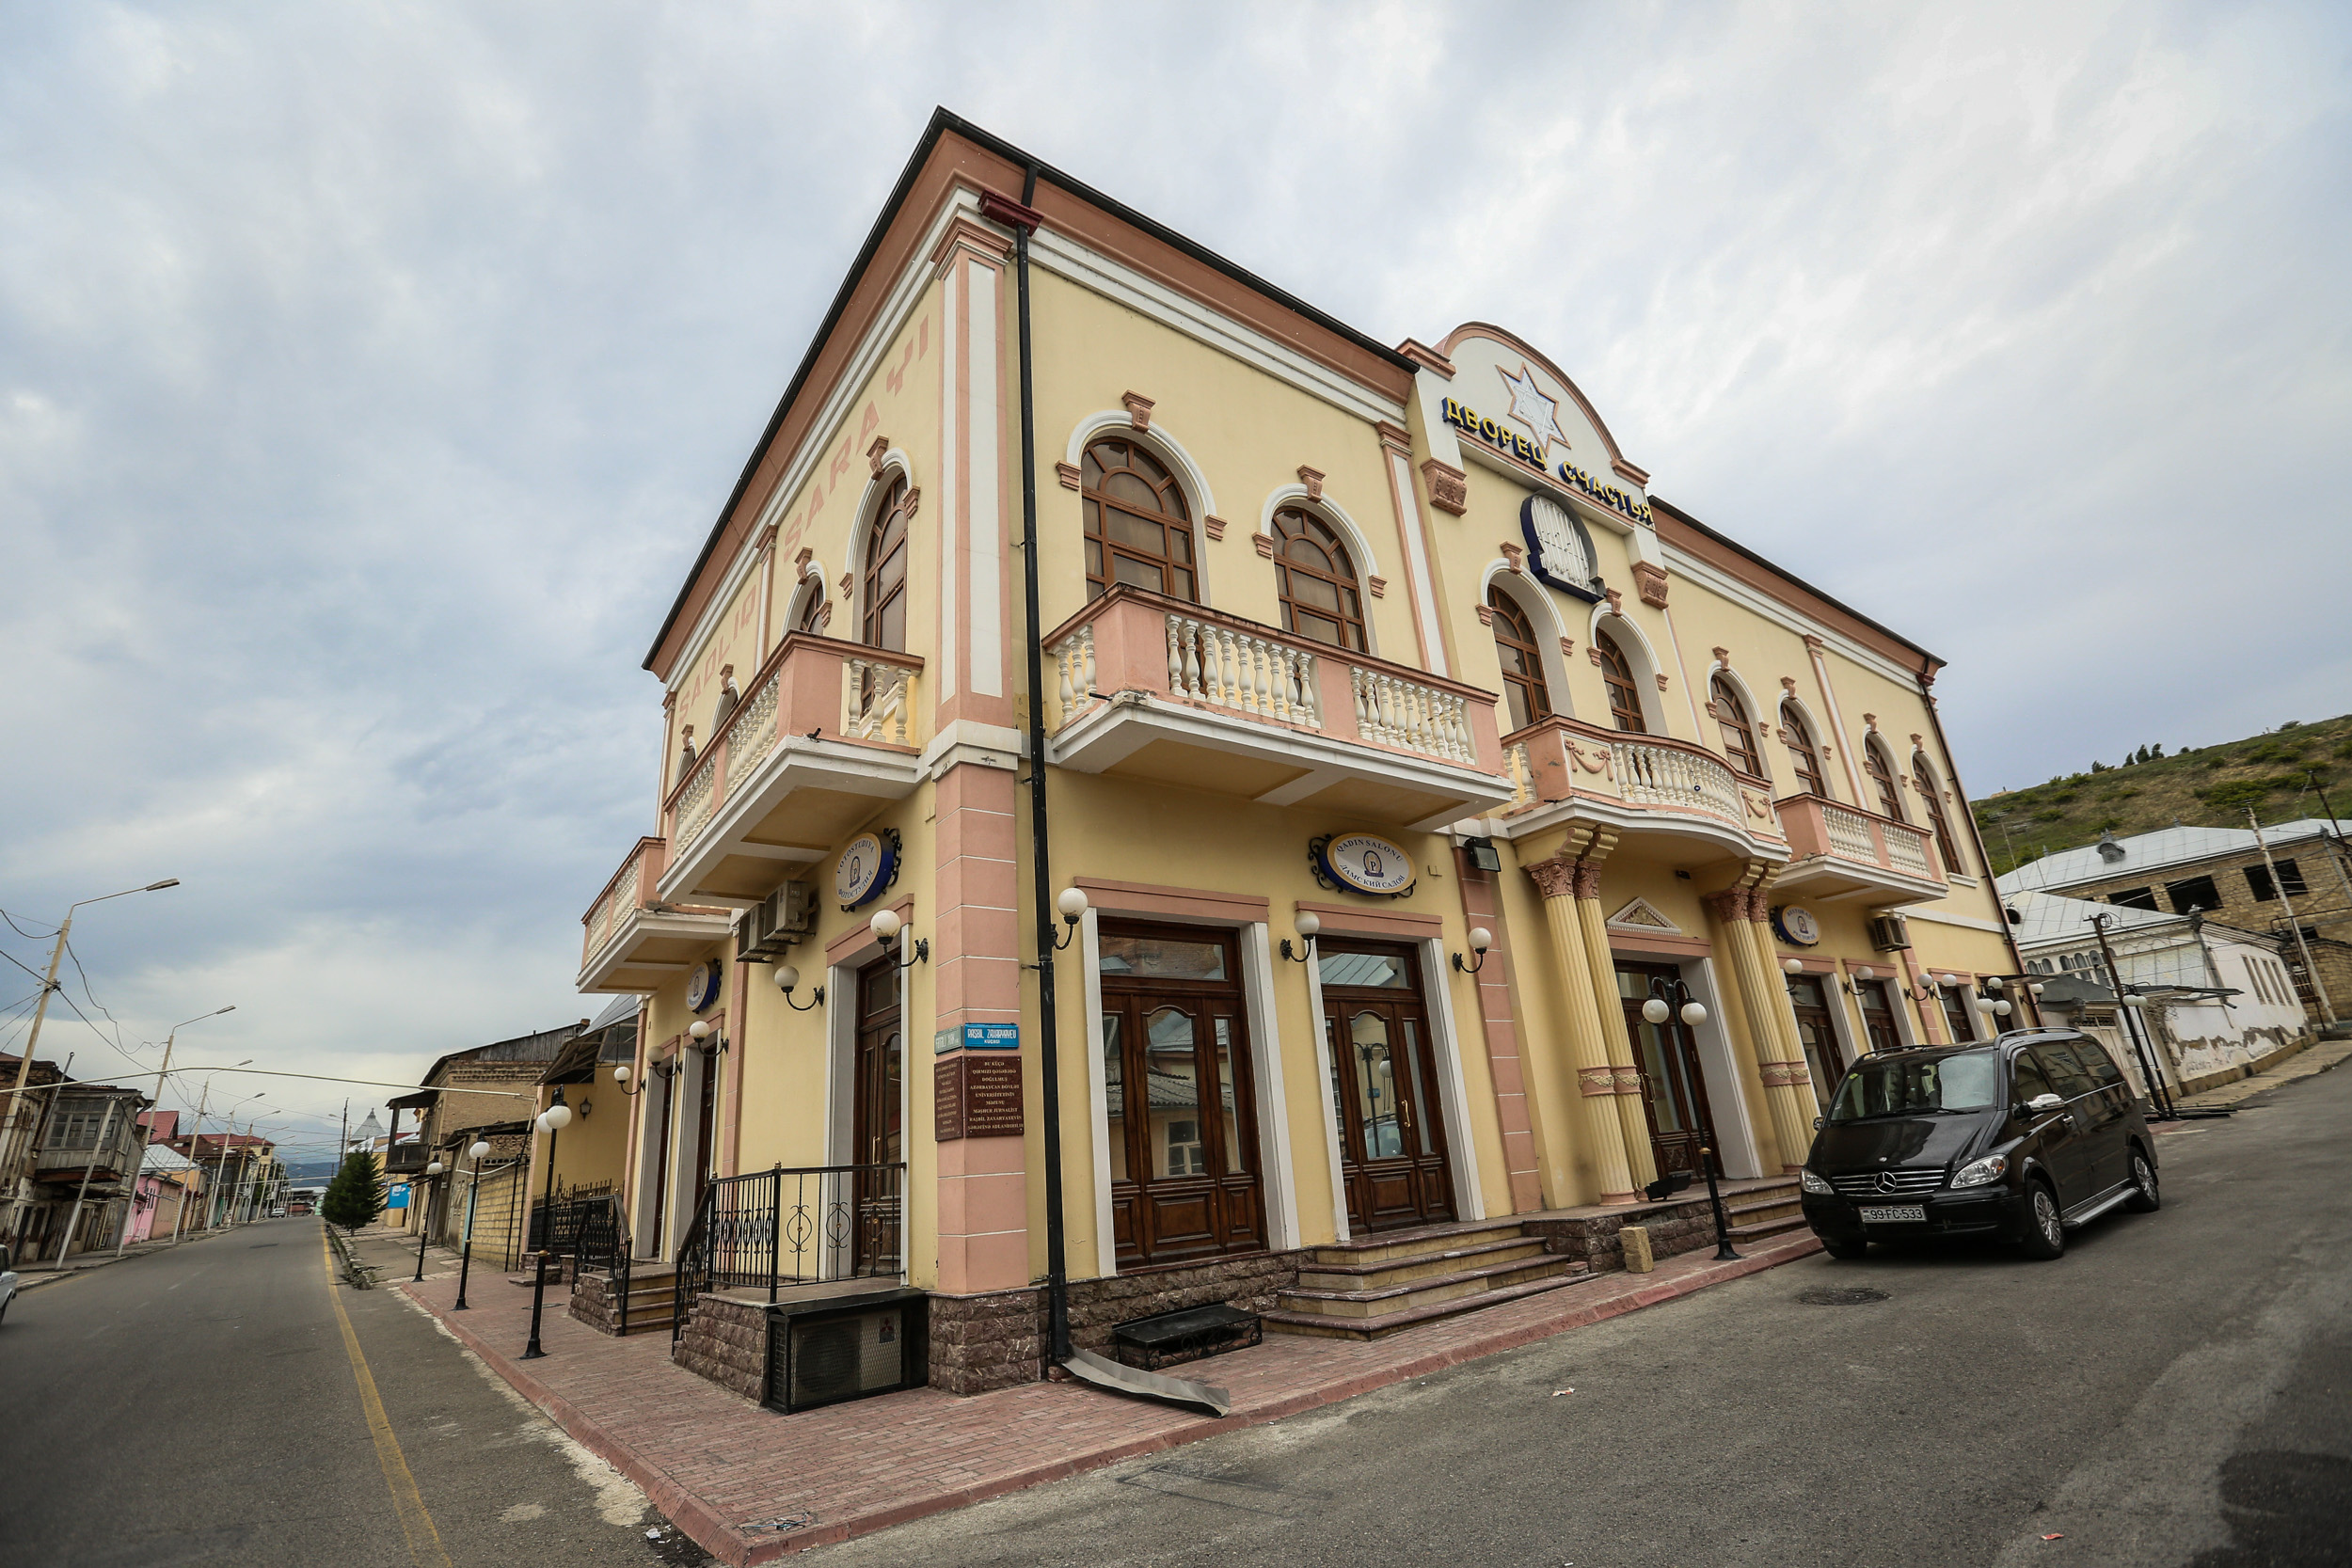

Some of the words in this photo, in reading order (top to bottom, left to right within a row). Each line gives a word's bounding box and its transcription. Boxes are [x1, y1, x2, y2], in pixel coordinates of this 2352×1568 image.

[784, 313, 929, 563] SARAYI
[1441, 397, 1548, 471] ДВОРЕЦ
[1558, 461, 1654, 525] СЧАСТЬЯ
[1337, 839, 1364, 852] QADIN
[1366, 840, 1403, 861] SALONU
[1870, 1209, 1922, 1219] 99-FC-533
